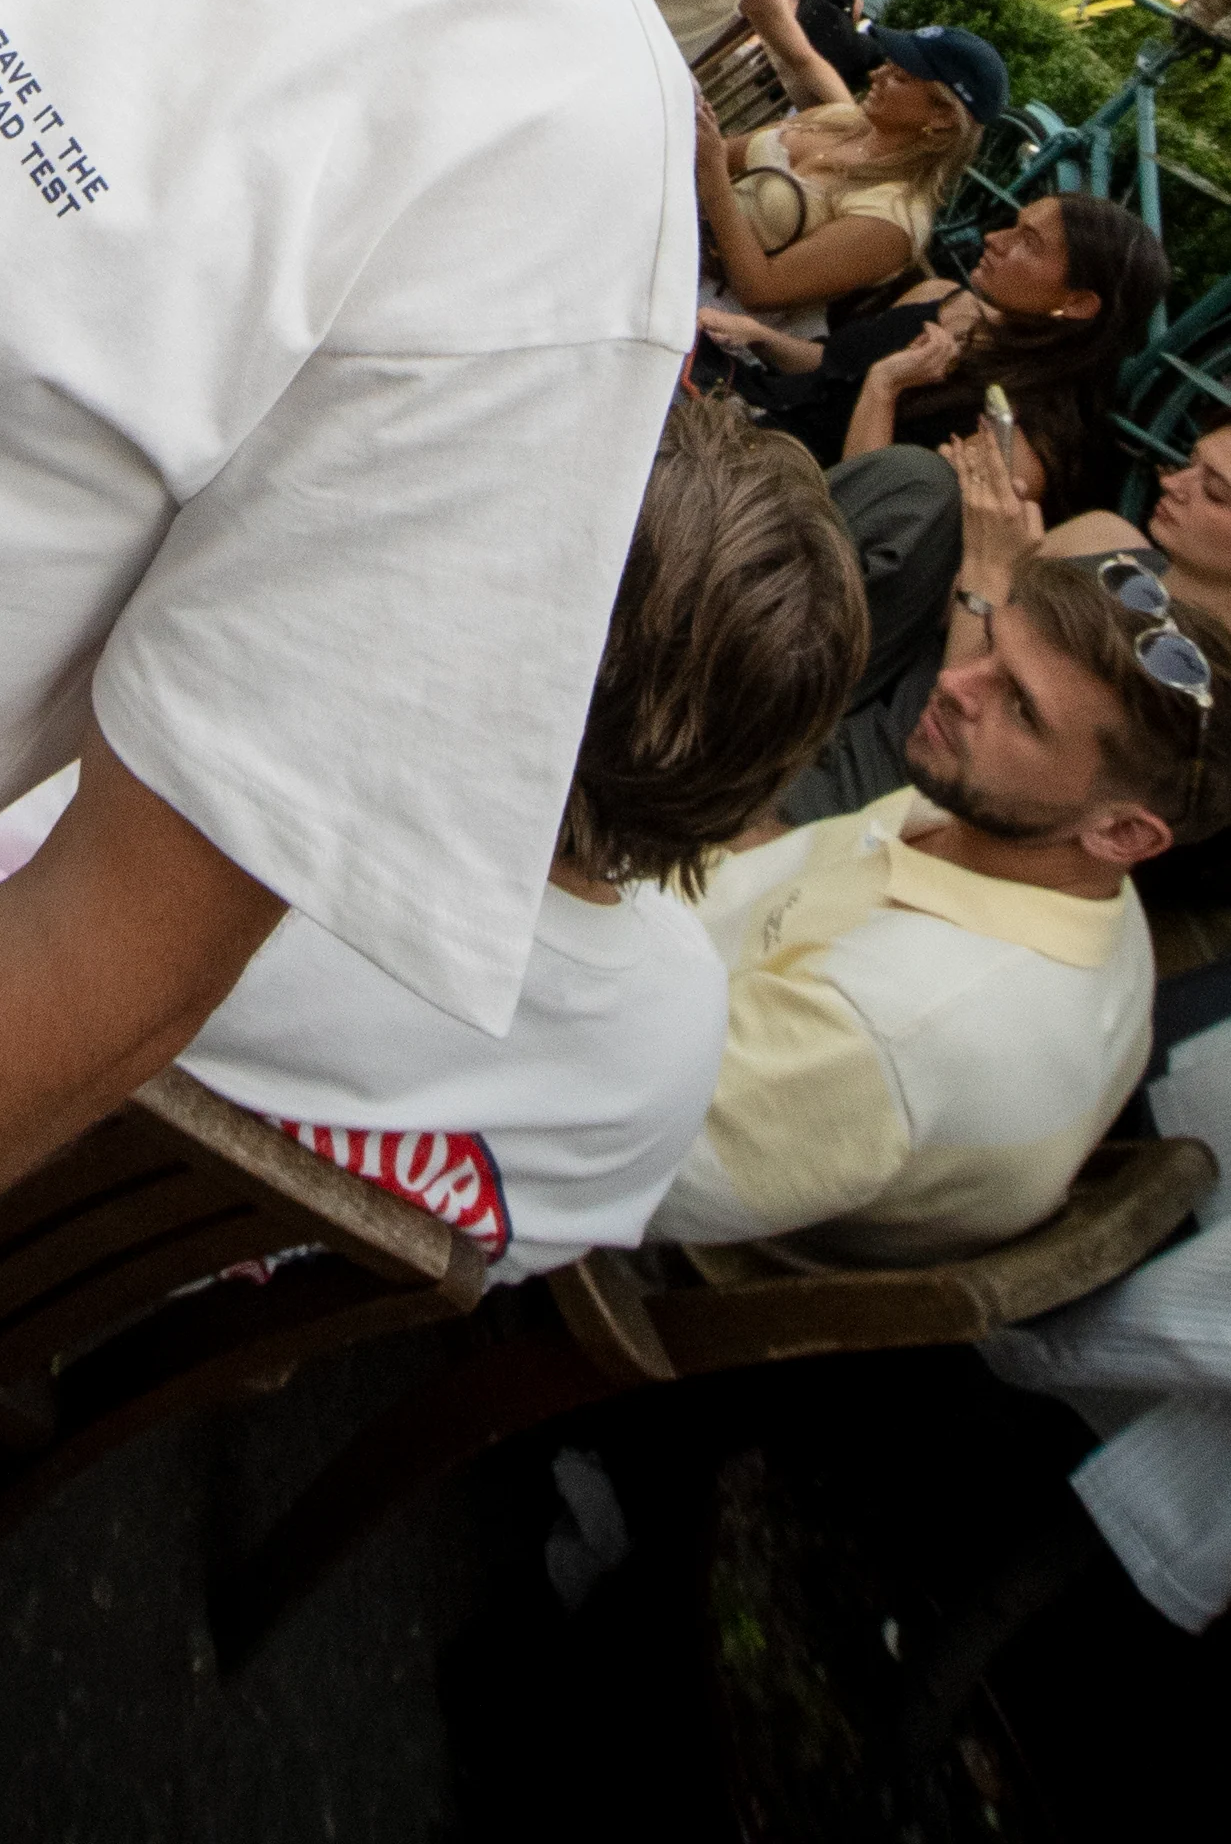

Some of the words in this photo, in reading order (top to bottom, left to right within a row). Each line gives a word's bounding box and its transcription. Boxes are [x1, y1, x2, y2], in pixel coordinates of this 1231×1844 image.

[20, 140, 82, 218] TEST
[33, 104, 65, 134] IT
[58, 136, 109, 204] THE
